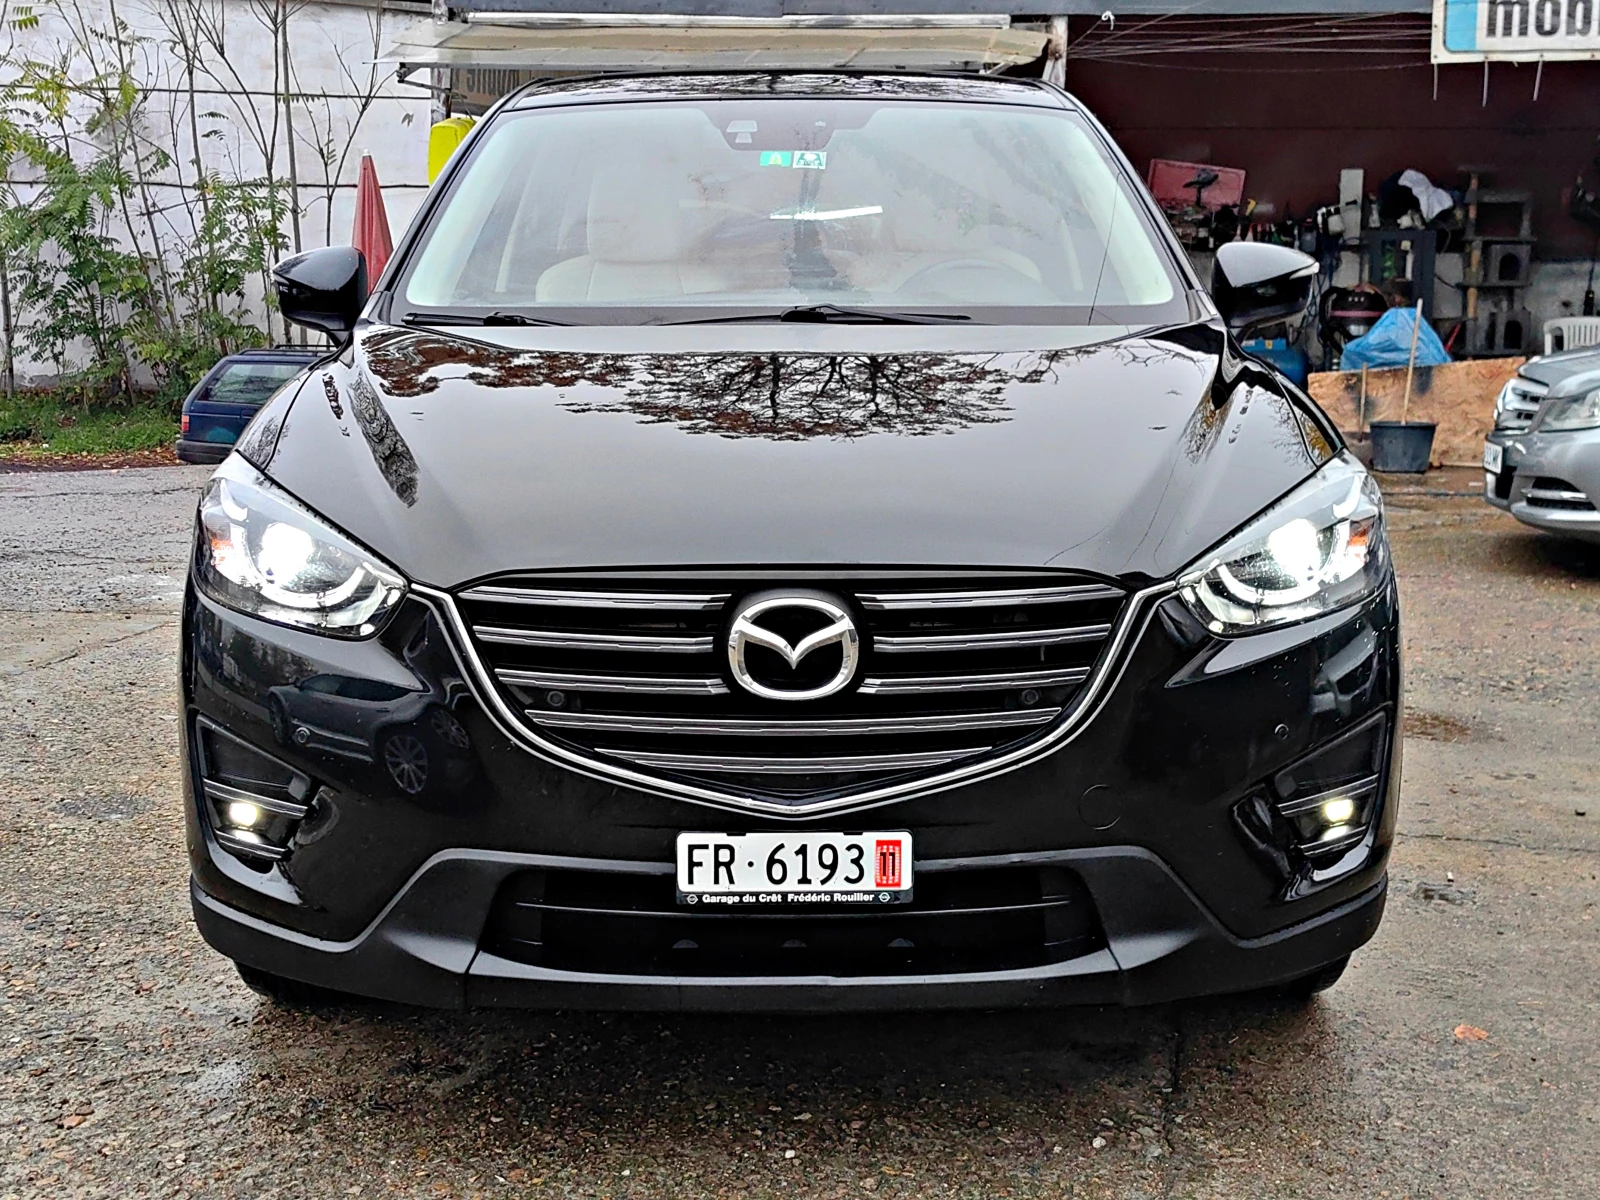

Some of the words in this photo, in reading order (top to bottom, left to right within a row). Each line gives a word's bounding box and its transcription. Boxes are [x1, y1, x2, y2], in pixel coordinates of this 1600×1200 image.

[1486, 0, 1600, 37] mob
[687, 843, 736, 885] FR
[766, 843, 865, 886] 6193
[880, 852, 896, 877] 11
[701, 894, 741, 905] Garage
[742, 893, 757, 903] du
[758, 893, 783, 903] Crêt
[787, 892, 832, 903] Frédéric
